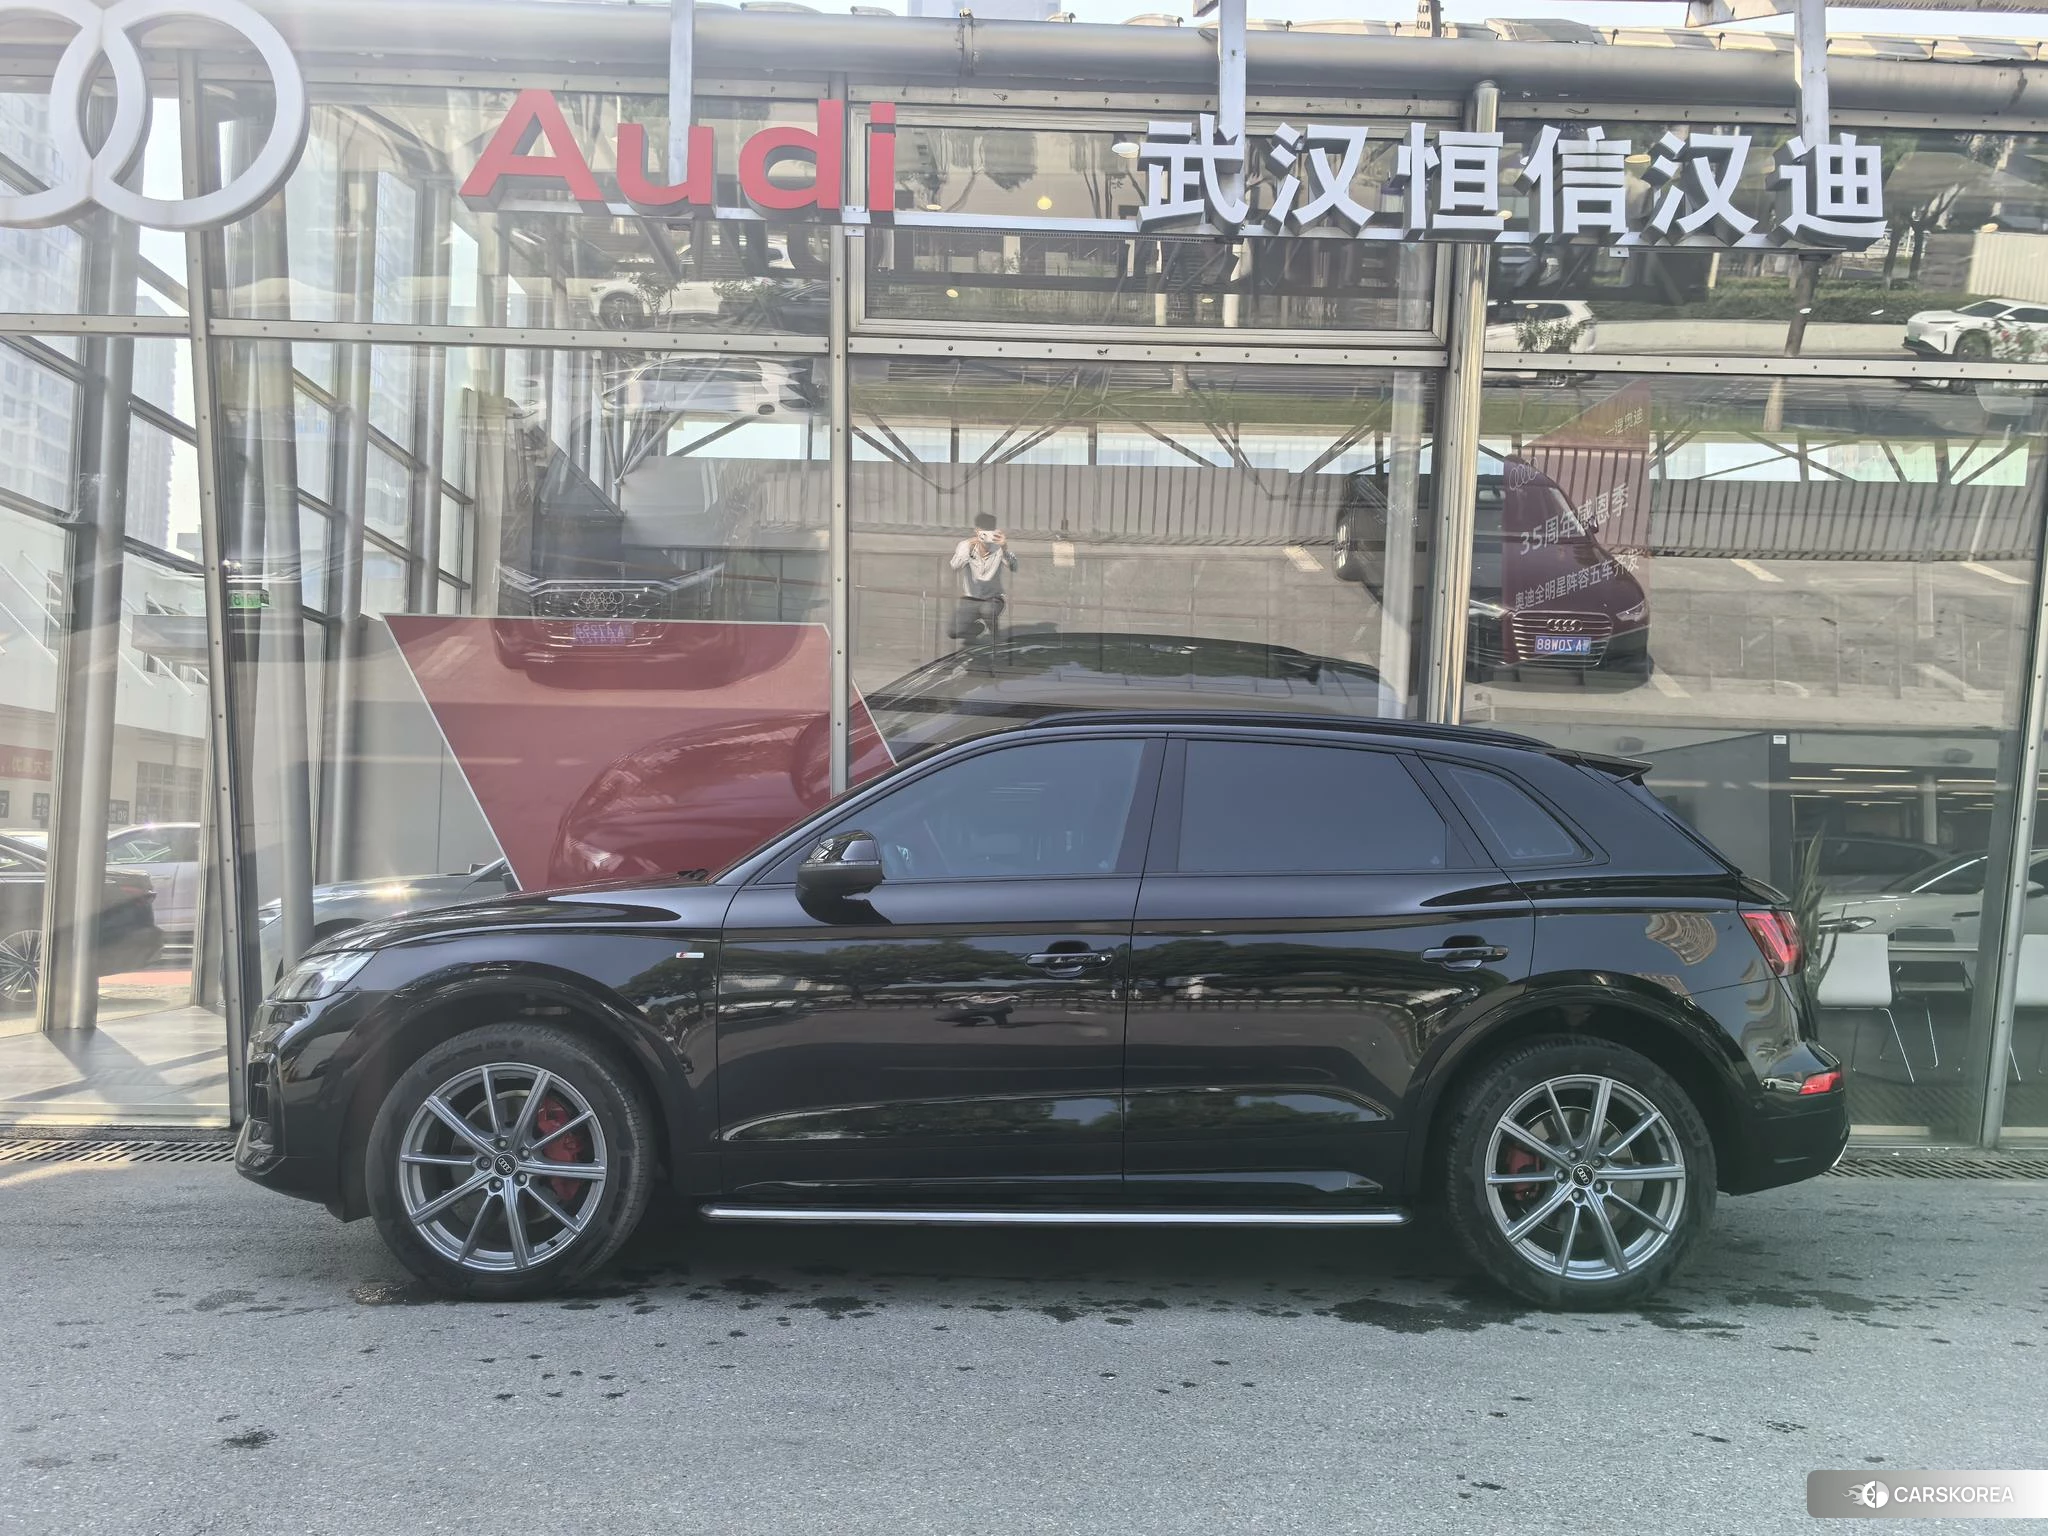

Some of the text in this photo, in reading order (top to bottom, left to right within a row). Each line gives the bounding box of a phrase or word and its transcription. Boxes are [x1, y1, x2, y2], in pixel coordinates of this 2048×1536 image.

[458, 88, 896, 212] Audi
[1139, 114, 1888, 240] 武汉恒信汉迪
[1520, 482, 1629, 555] 35周年感恩季
